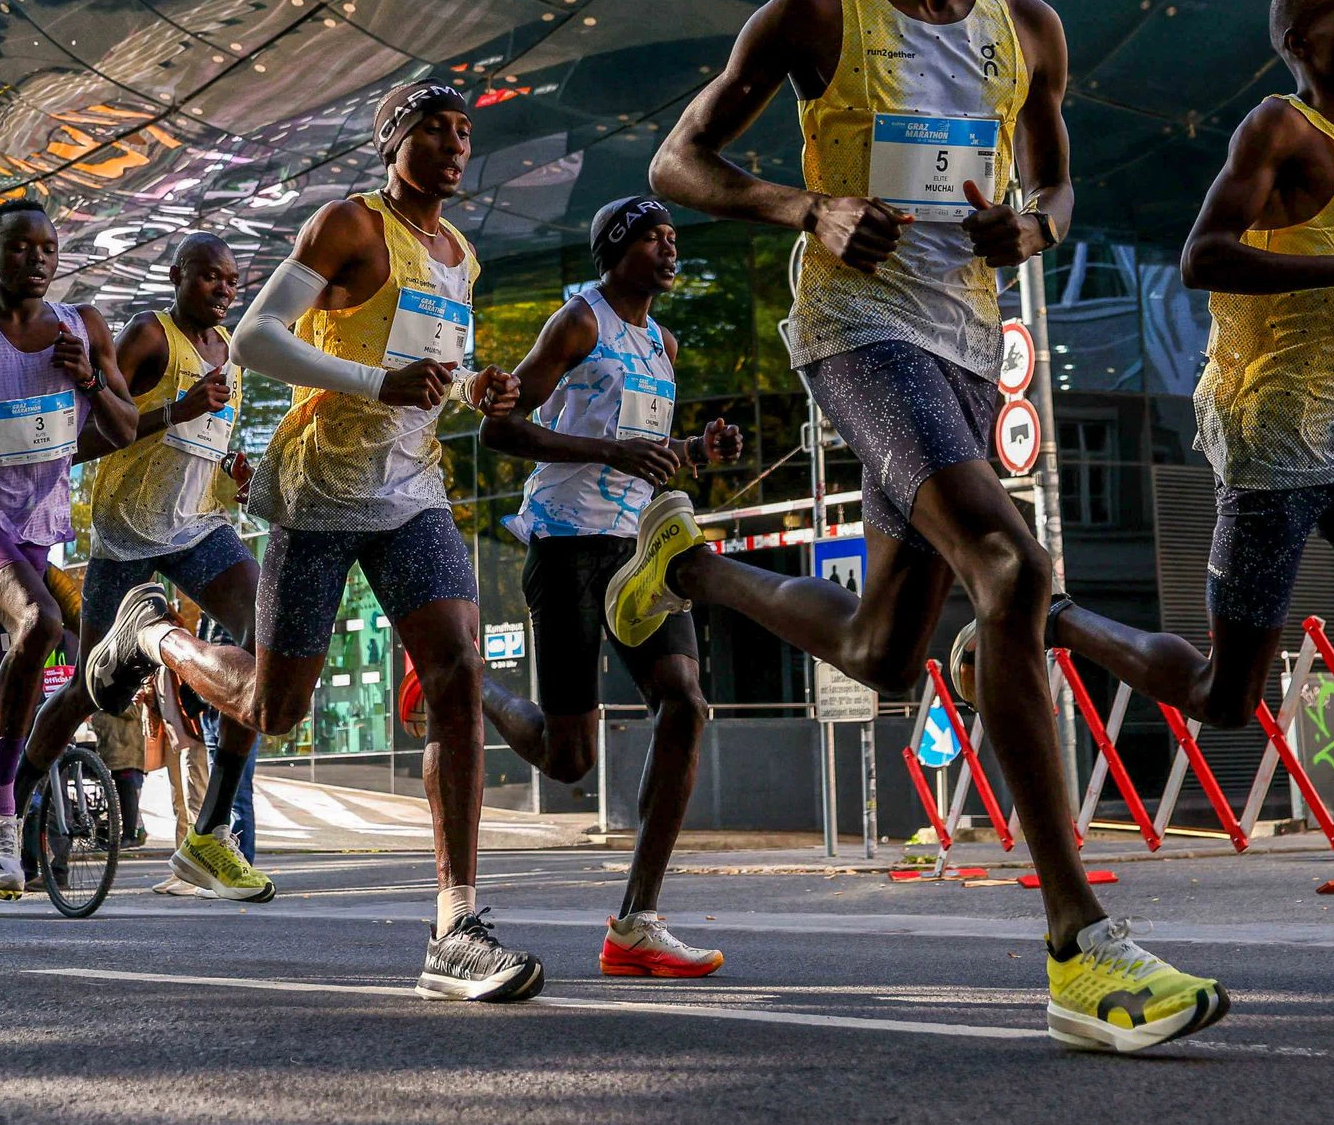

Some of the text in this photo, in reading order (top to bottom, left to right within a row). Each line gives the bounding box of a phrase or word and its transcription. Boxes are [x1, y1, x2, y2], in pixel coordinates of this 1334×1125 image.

[867, 49, 916, 59] run2gether
[907, 122, 929, 131] GRAZ
[905, 130, 949, 140] MARATHON
[935, 150, 949, 173] 5
[925, 184, 954, 192] MUCHAI
[435, 322, 443, 339] 2
[650, 398, 657, 413] 4
[35, 417, 45, 431] 3
[661, 524, 680, 542] ON
[485, 621, 524, 633] Kunsthaus
[429, 956, 471, 981] RUNNING
